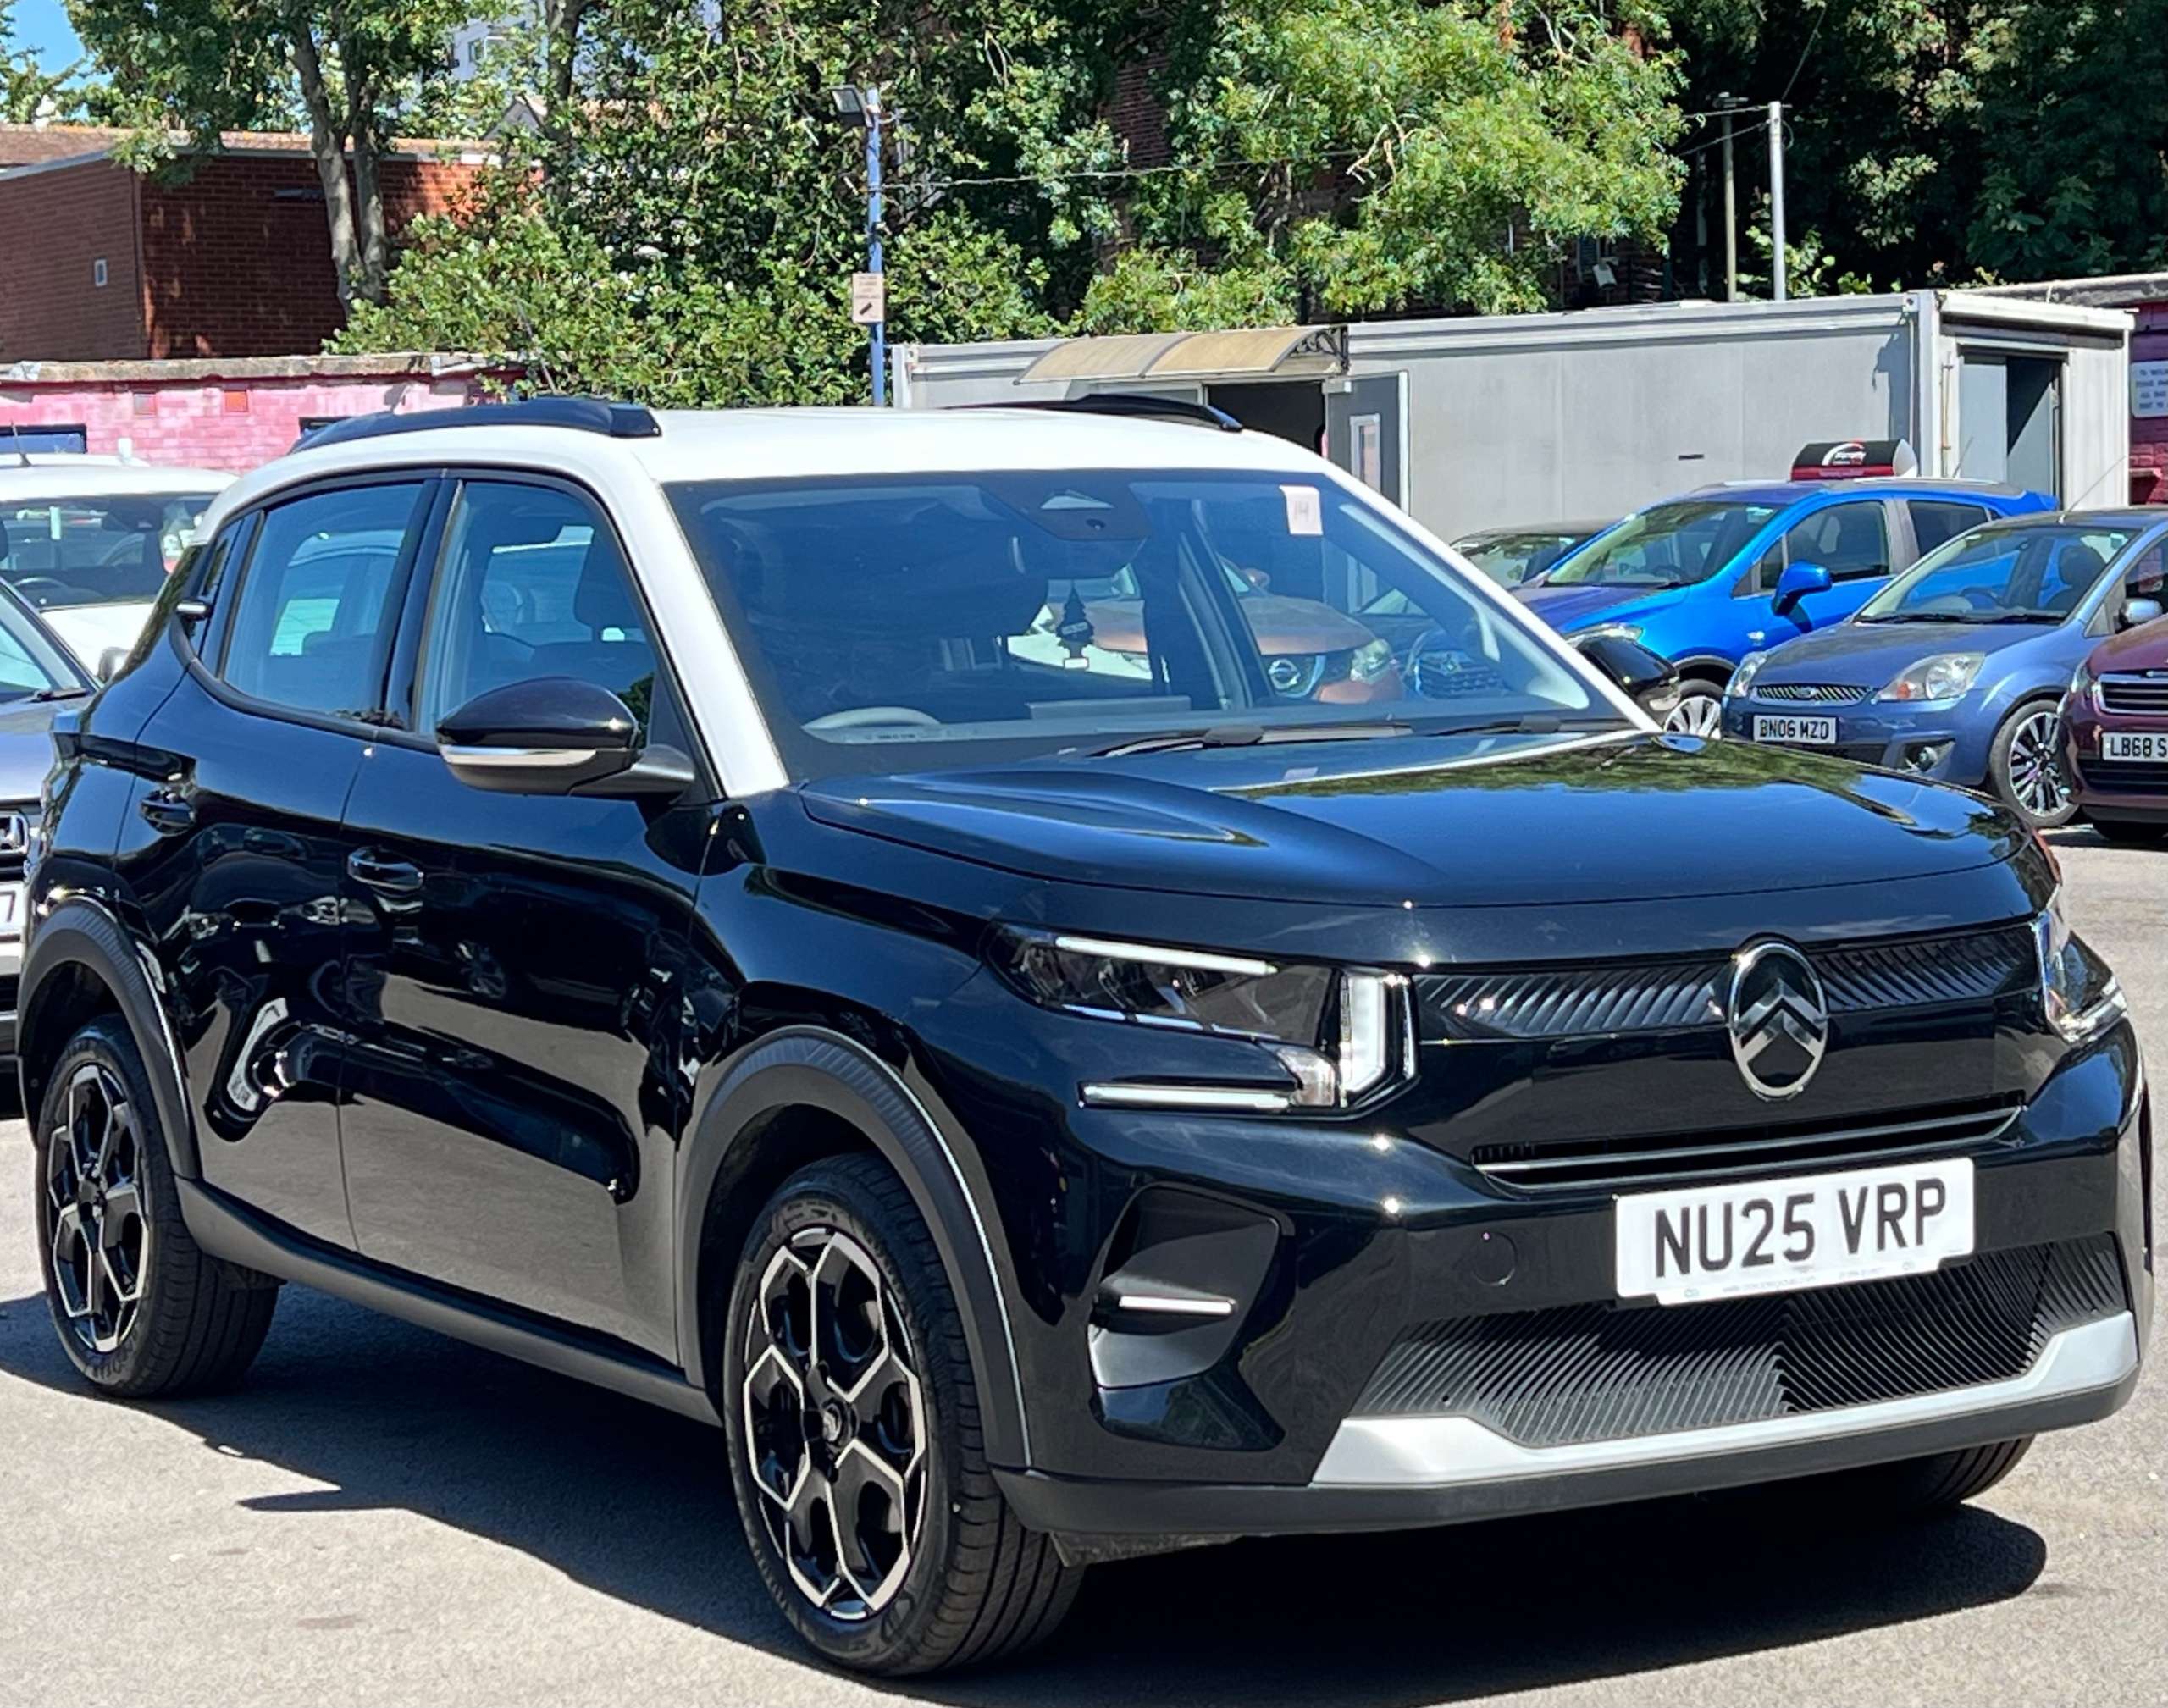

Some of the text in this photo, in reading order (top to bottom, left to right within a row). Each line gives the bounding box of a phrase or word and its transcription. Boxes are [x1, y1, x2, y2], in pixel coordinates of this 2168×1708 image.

[1759, 719, 1796, 738] BN06
[2110, 736, 2153, 757] LB68
[1655, 1177, 1946, 1279] NU25 VRP
